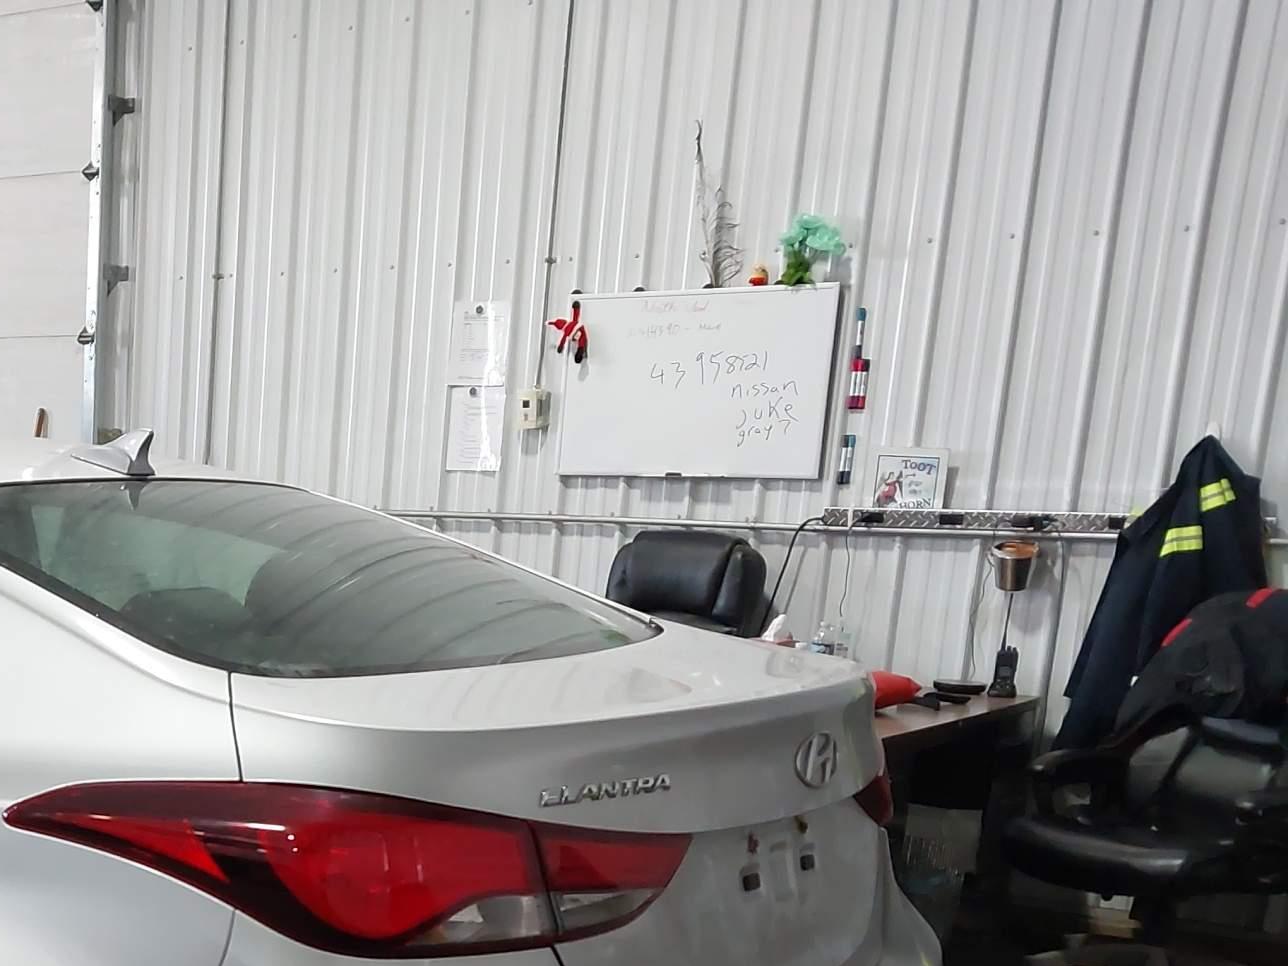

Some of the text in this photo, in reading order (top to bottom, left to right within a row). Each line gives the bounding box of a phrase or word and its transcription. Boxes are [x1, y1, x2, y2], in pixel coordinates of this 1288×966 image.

[901, 459, 937, 475] TOOT
[899, 497, 932, 509] HORN
[539, 774, 672, 807] ELANTRA
